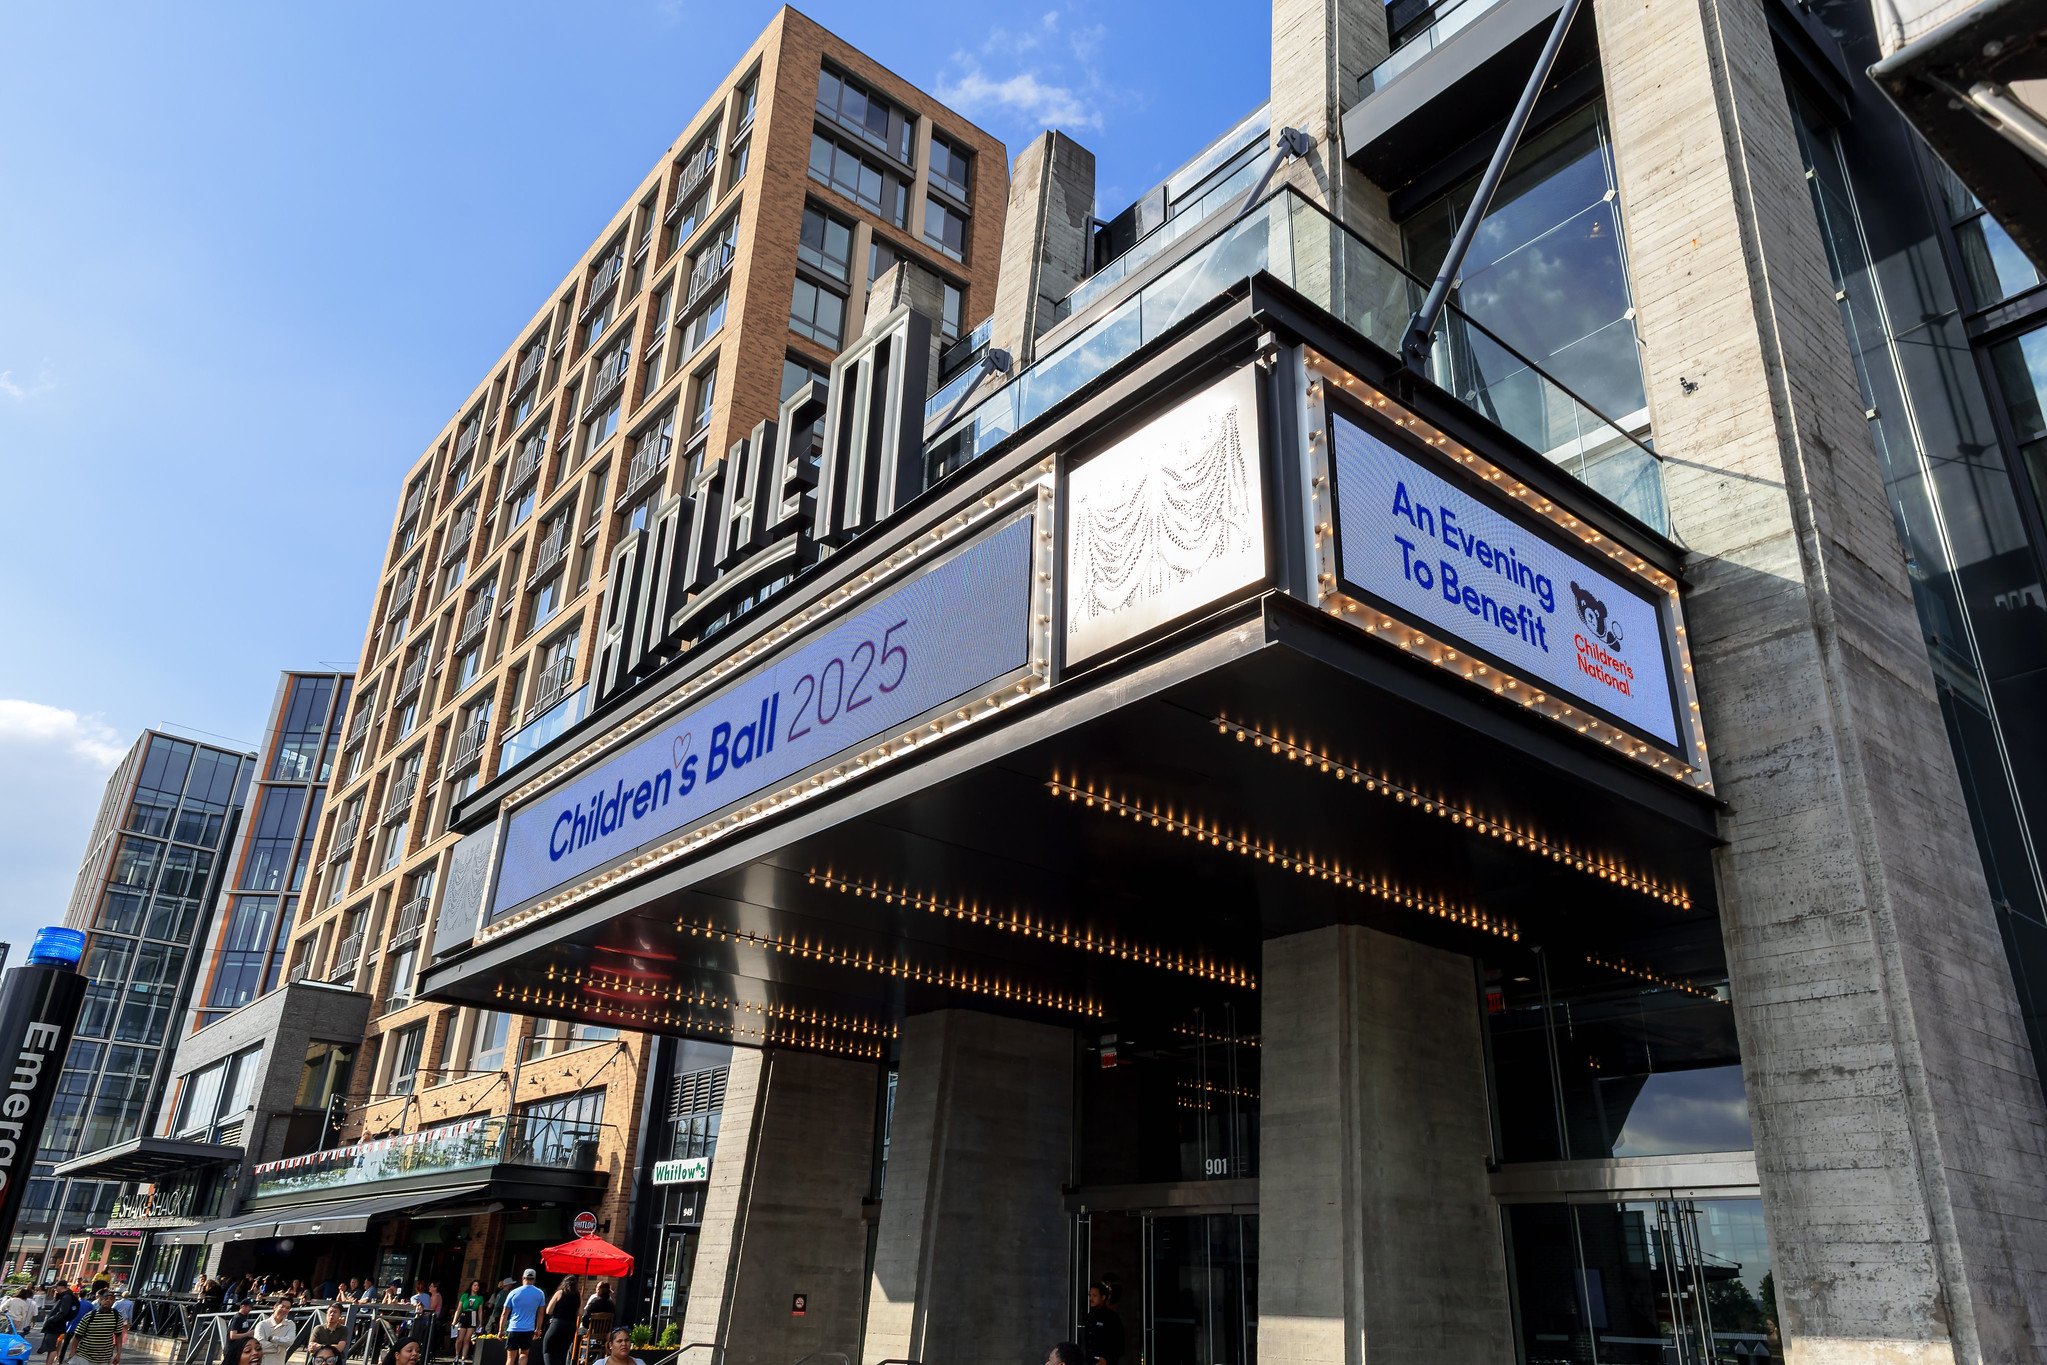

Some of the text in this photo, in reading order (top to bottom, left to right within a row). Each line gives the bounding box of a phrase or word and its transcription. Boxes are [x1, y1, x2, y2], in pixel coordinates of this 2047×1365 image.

[588, 303, 929, 715] ANTHEM
[1392, 481, 1556, 614] An Evening
[1394, 534, 1549, 654] To Benefit
[1573, 633, 1634, 680] Children's
[1576, 653, 1631, 697] National
[705, 691, 780, 785] Ball
[786, 619, 909, 744] 2025
[656, 1162, 706, 1182] Whitlow's
[1205, 1158, 1227, 1175] 901
[149, 1189, 184, 1217] SHACK
